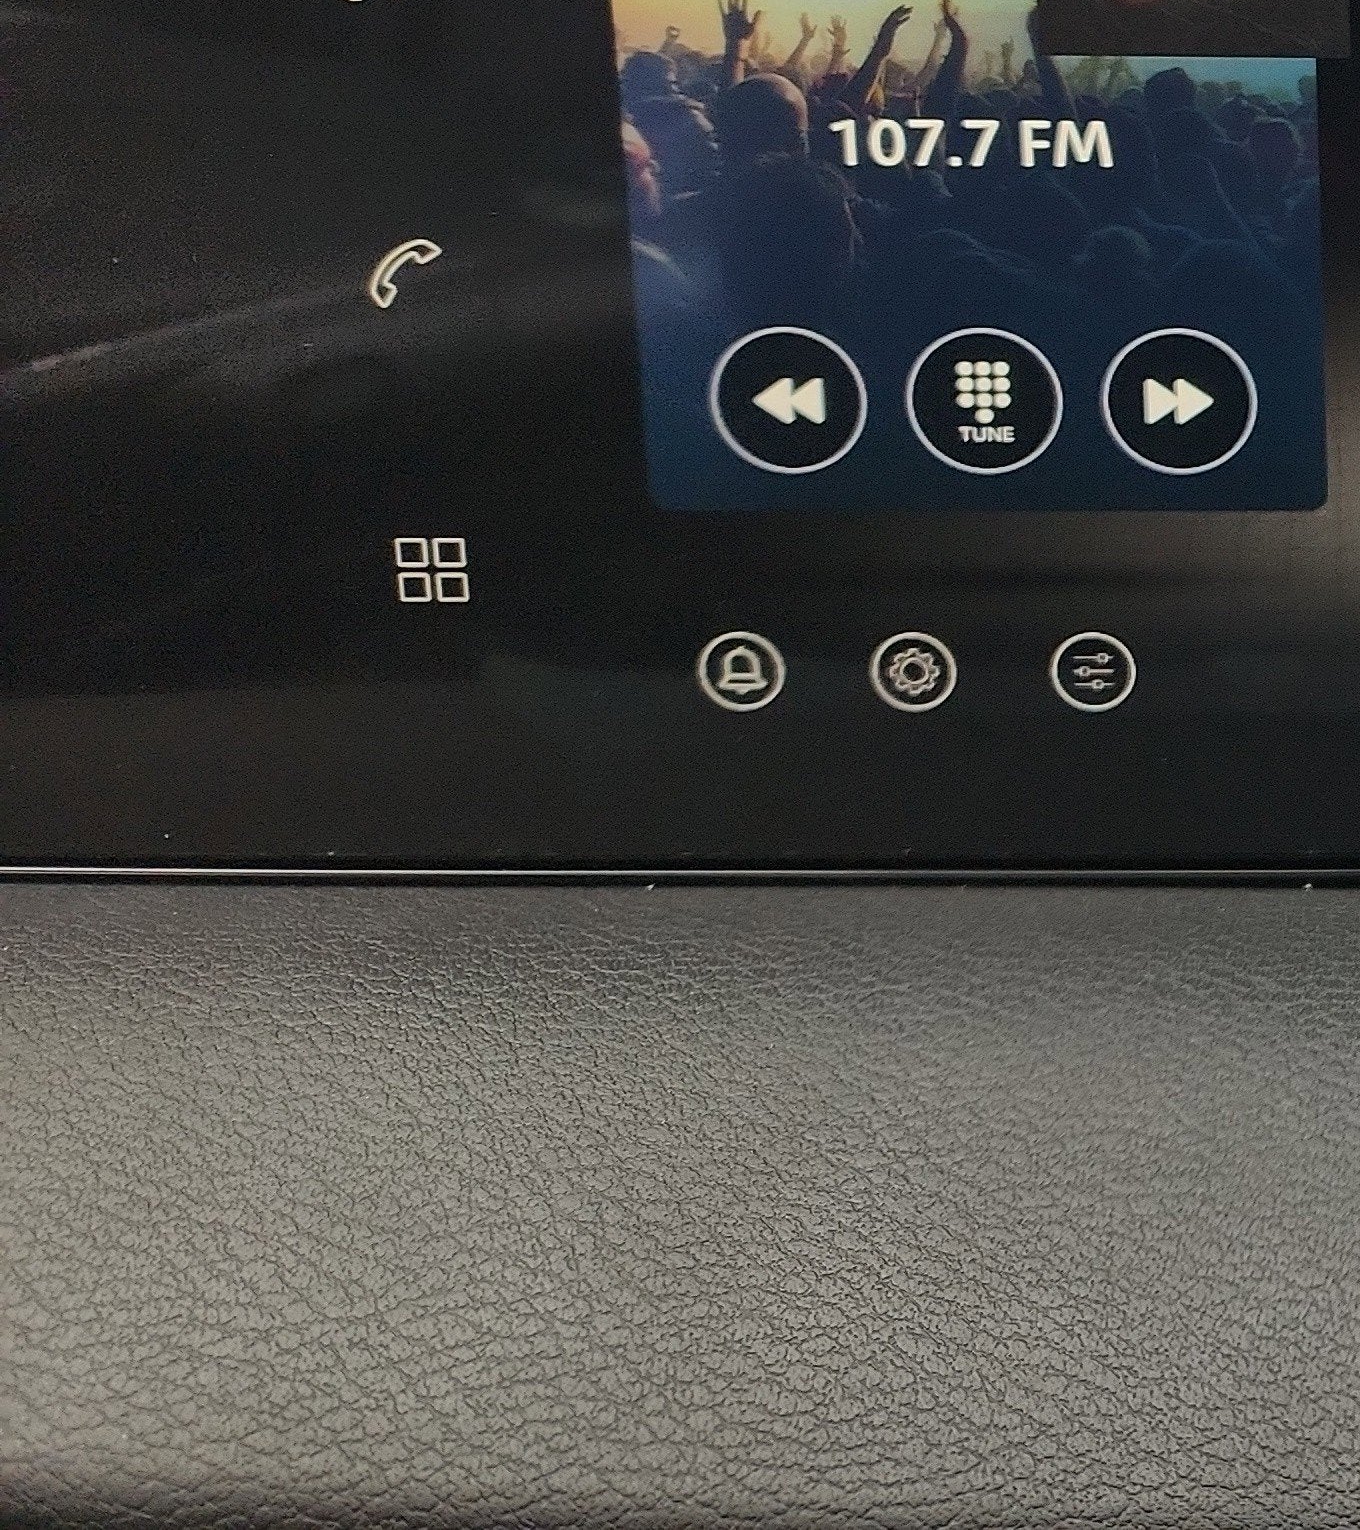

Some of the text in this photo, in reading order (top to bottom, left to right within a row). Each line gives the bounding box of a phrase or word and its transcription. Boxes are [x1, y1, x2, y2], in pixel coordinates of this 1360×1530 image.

[829, 118, 1115, 169] 107.7 FM
[958, 425, 1016, 444] TUNE
